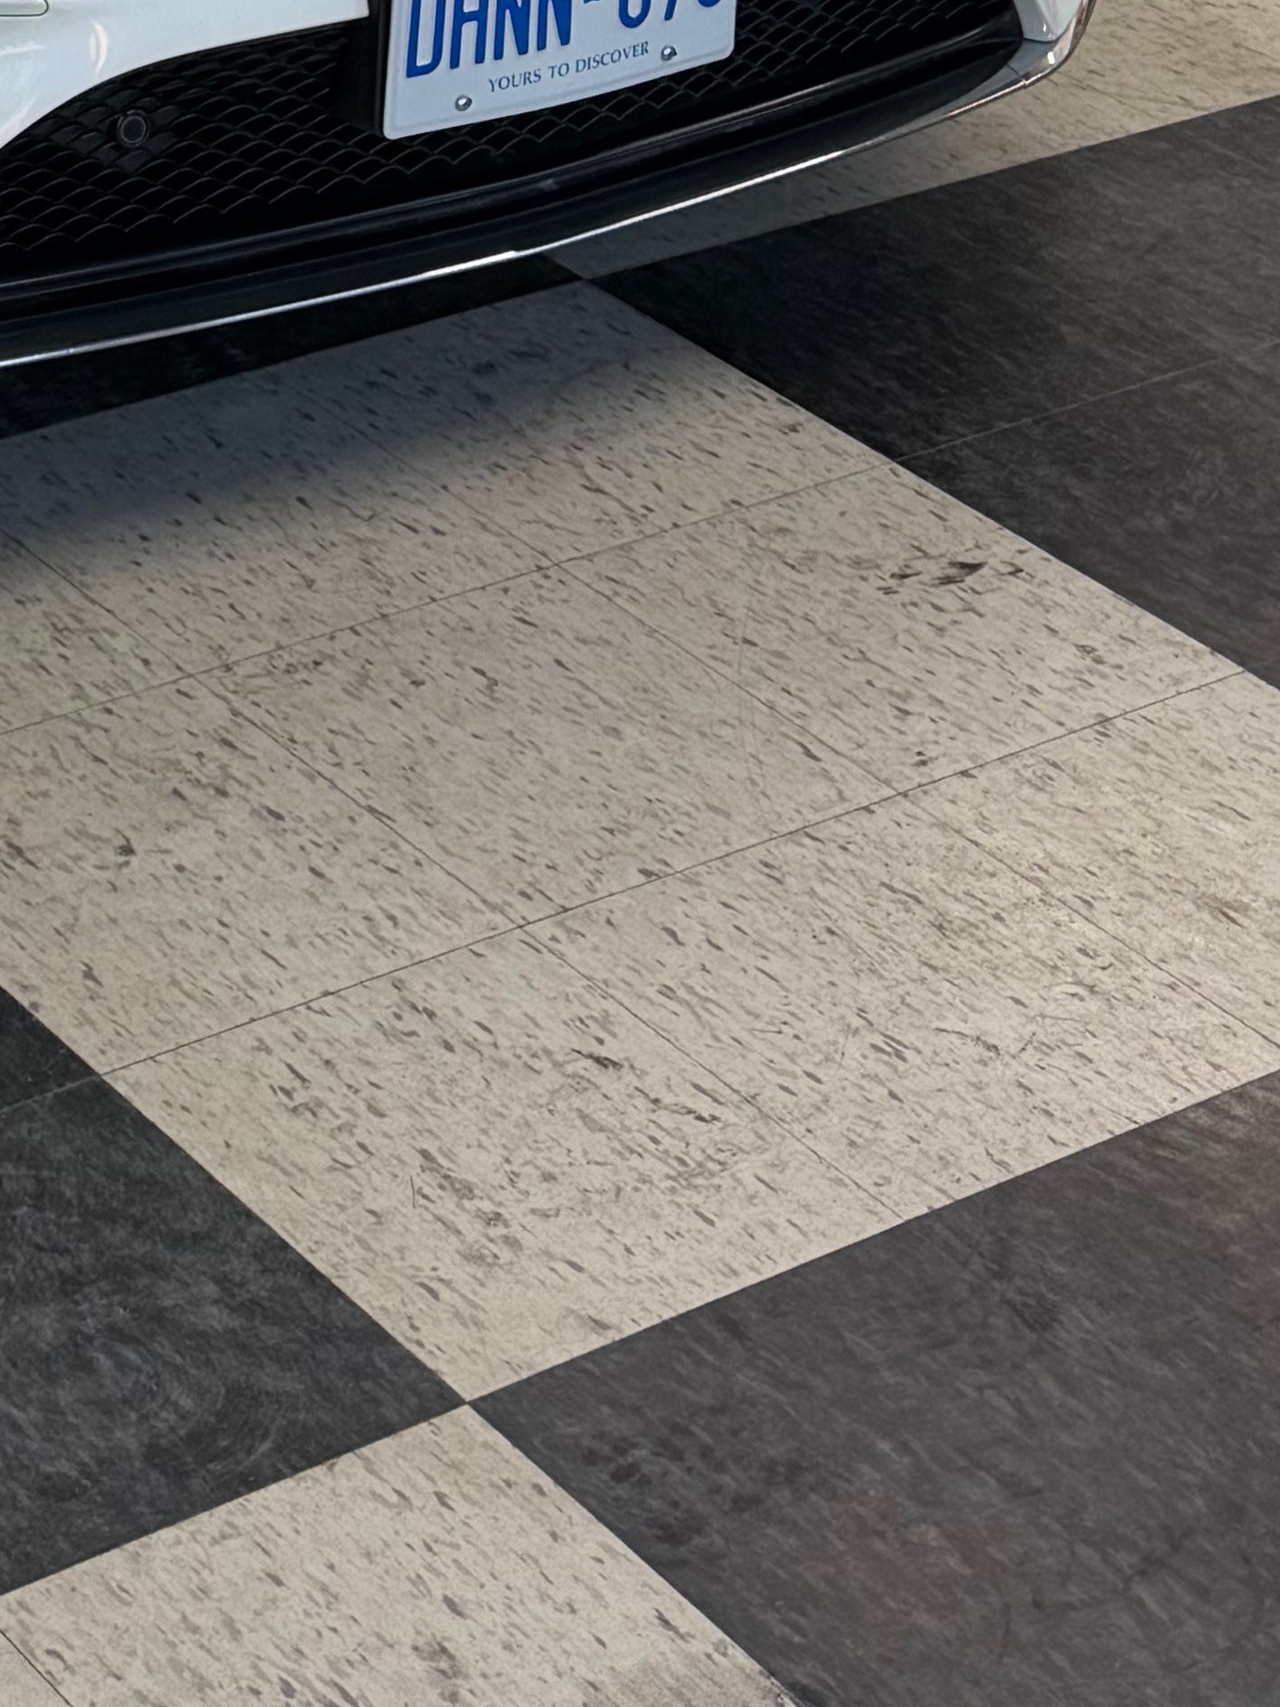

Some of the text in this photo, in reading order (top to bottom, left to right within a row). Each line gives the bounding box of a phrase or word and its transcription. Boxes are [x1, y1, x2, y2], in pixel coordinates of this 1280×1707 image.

[487, 40, 650, 93] YOURS TO DISCOVER
